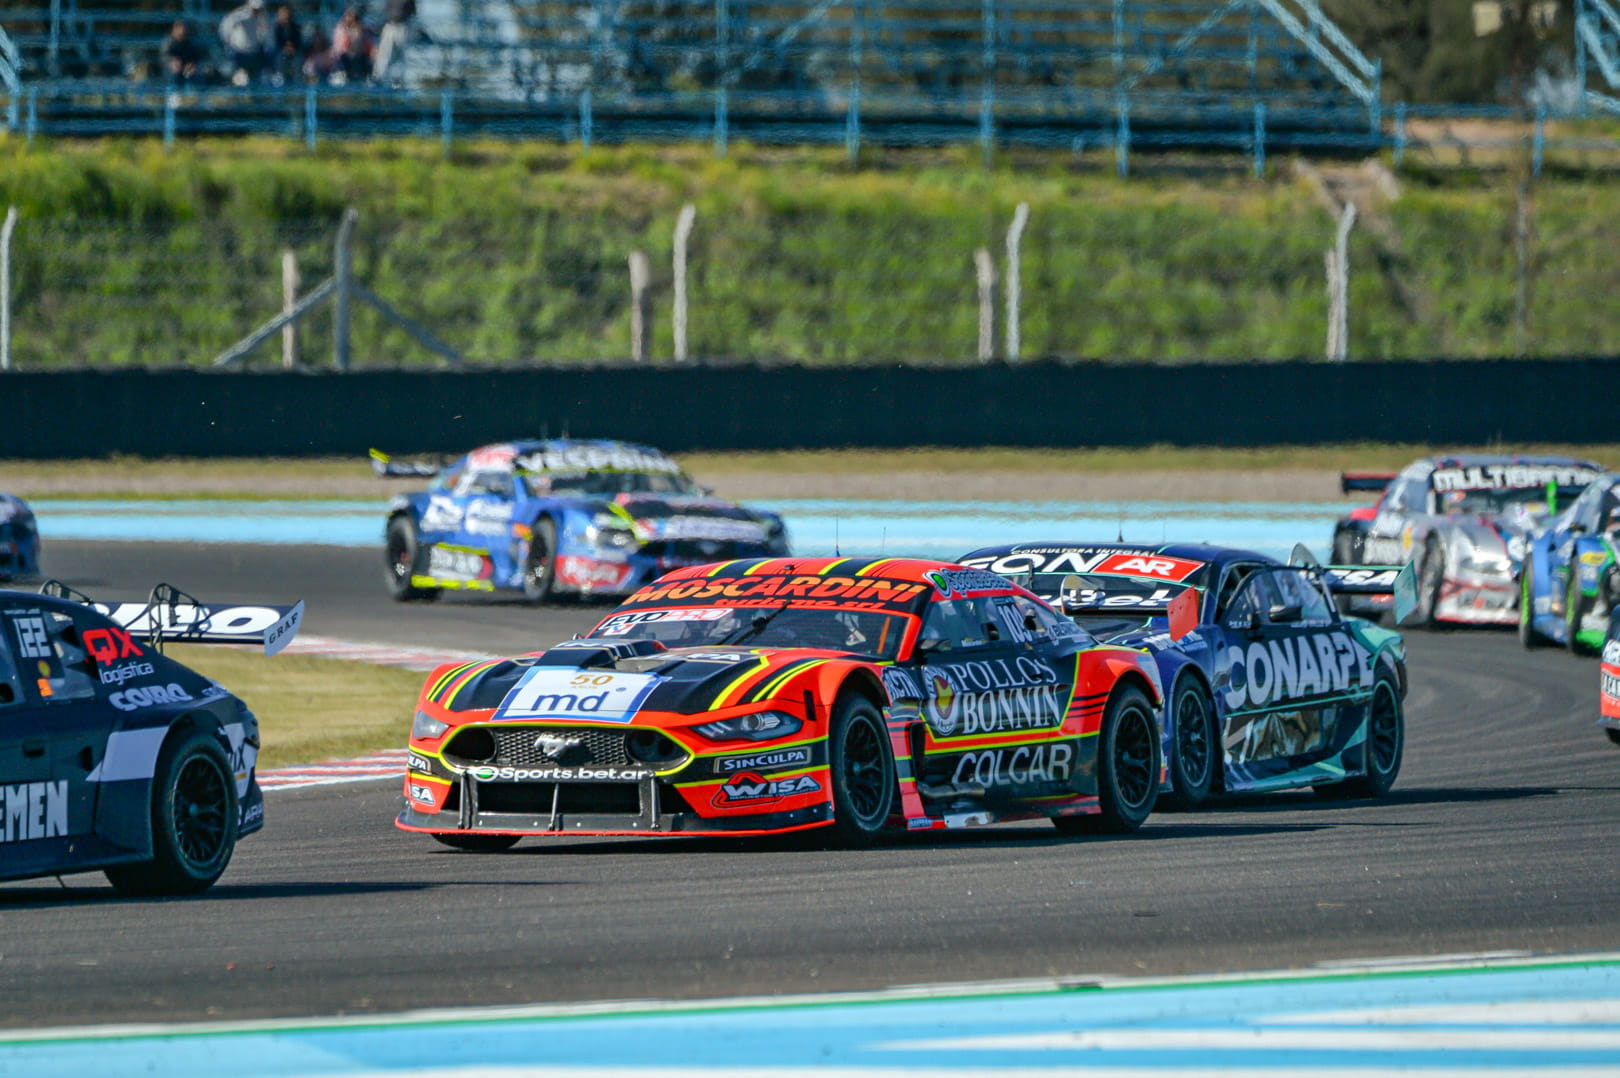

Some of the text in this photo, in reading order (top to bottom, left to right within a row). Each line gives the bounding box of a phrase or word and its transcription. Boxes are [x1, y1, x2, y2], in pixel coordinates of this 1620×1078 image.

[1096, 548, 1155, 557] INTEGRAL
[1114, 558, 1177, 576] AR
[622, 576, 928, 605] MOSCARDINI
[13, 617, 52, 658] 122
[268, 611, 299, 644] GRAF
[82, 627, 144, 666] QX
[570, 674, 614, 685] 50
[947, 656, 1057, 691] POLLOS
[531, 691, 611, 712] md
[962, 683, 1060, 734] BONNIN
[724, 751, 805, 770] SINCULPA
[952, 744, 1072, 789] COLCAR
[723, 776, 817, 797] WISA
[0, 780, 68, 842] MEN
